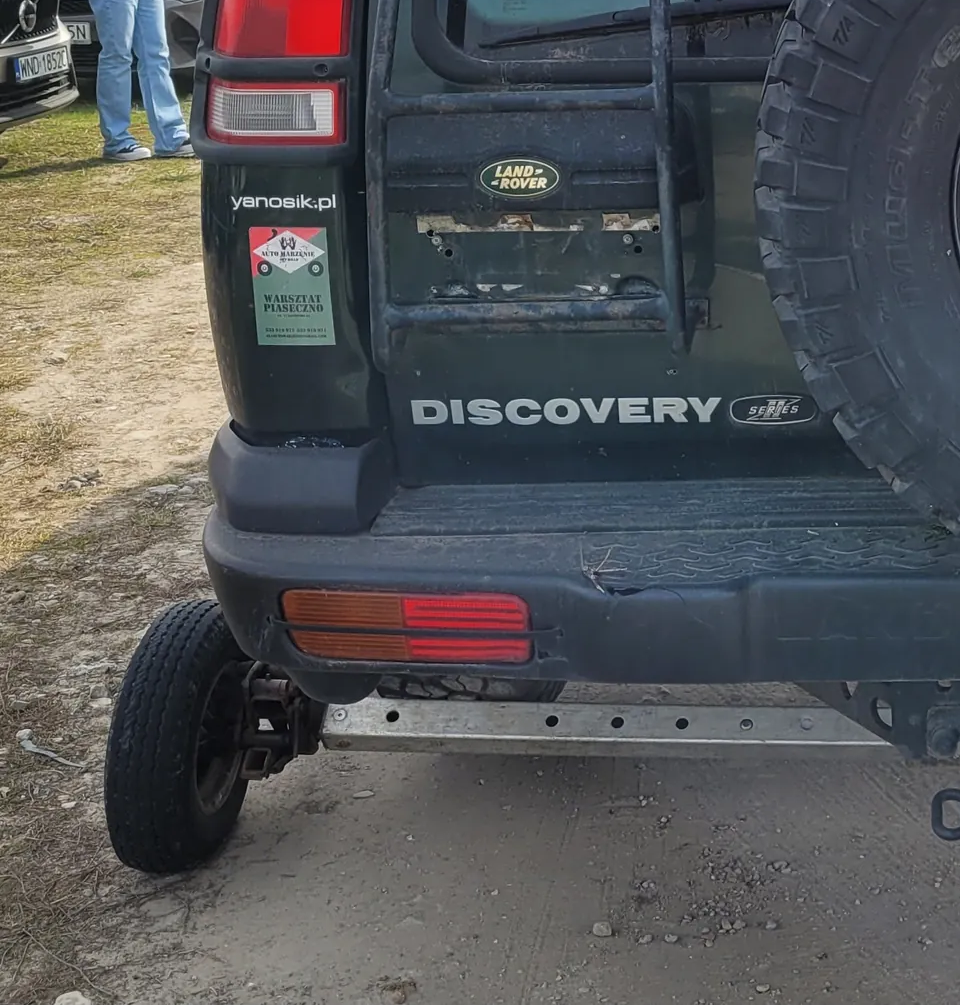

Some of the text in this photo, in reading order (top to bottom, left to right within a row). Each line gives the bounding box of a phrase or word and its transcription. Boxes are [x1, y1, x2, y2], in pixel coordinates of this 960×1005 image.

[20, 56, 40, 78] WND
[495, 165, 534, 178] LAND
[500, 177, 548, 190] ROVER
[231, 194, 336, 212] yanosik.pl
[263, 294, 322, 304] WARSZTAT
[263, 304, 324, 313] PIASECZNO
[410, 397, 722, 426] DISCOVERY
[748, 405, 800, 415] SERIES
